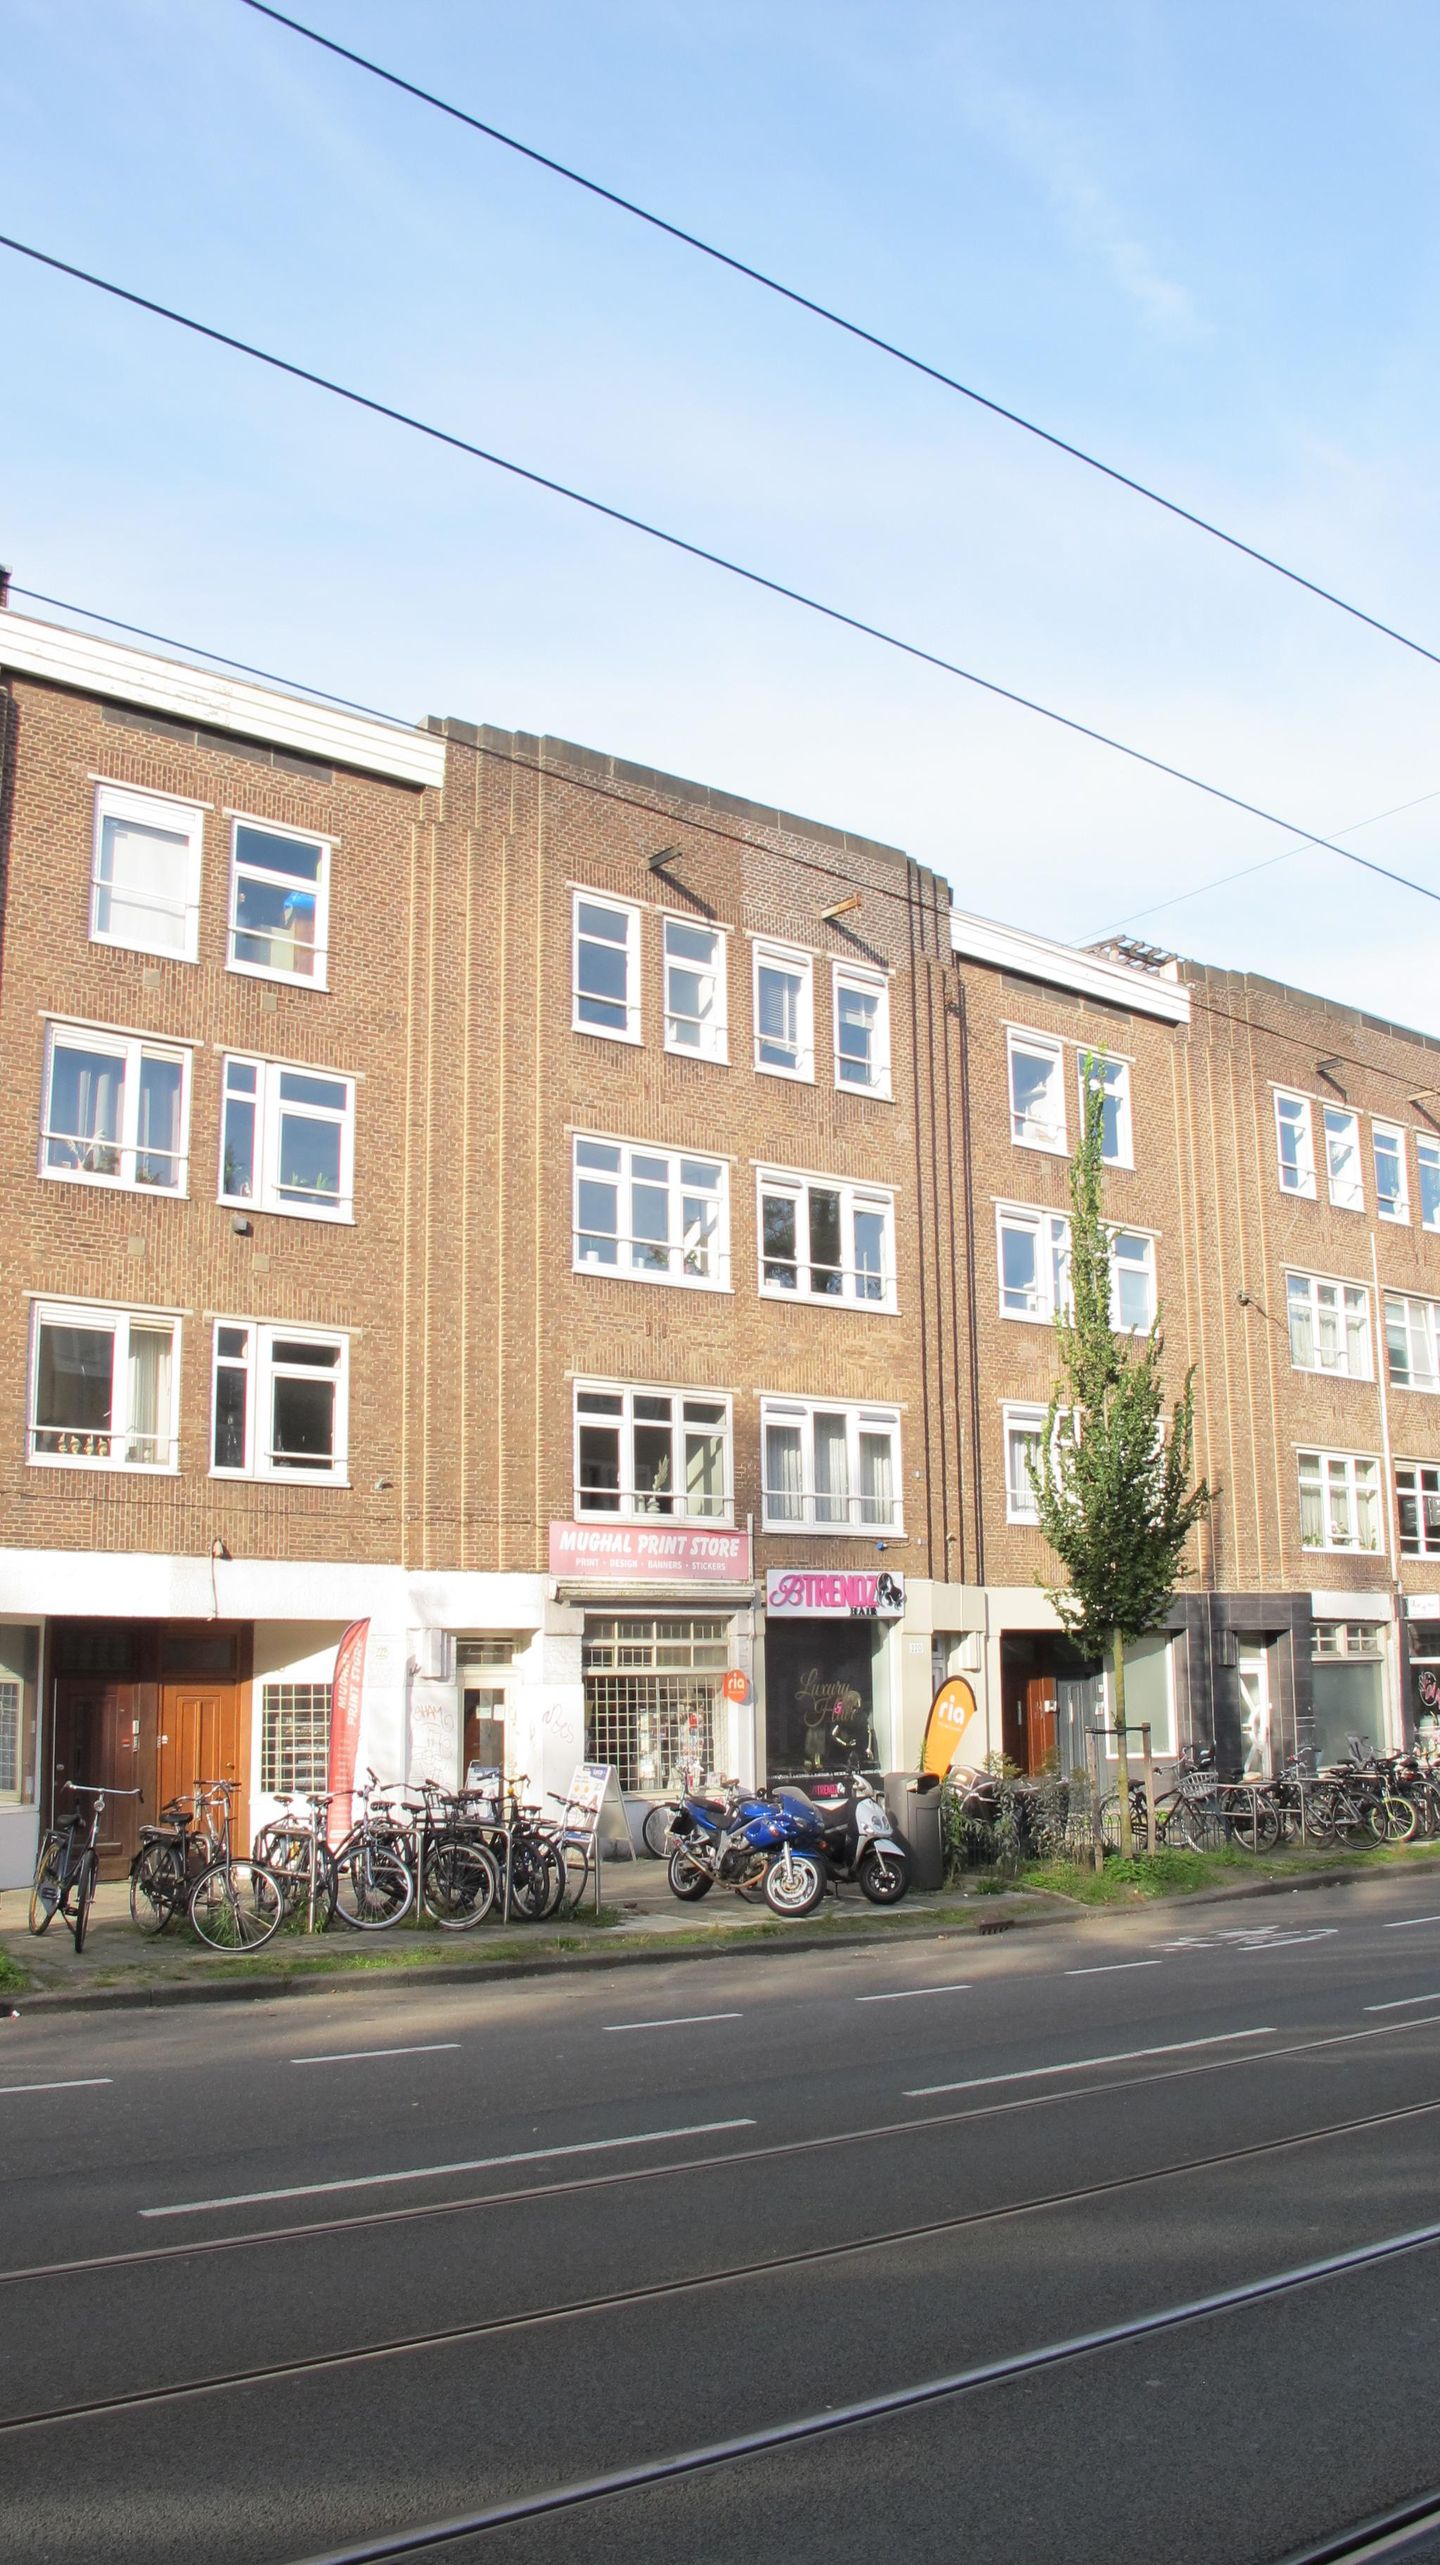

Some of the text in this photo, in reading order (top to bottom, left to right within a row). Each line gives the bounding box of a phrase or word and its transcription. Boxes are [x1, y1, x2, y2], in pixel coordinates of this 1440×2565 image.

[560, 1531, 740, 1557] MUGHAL PRINT STORE
[575, 1558, 726, 1571] PRINT DESIGN BANNERS STICKERS
[850, 1607, 877, 1616] HAIR
[728, 1672, 745, 1689] ria
[346, 1685, 361, 1726] PRINT
[939, 1695, 965, 1725] ria
